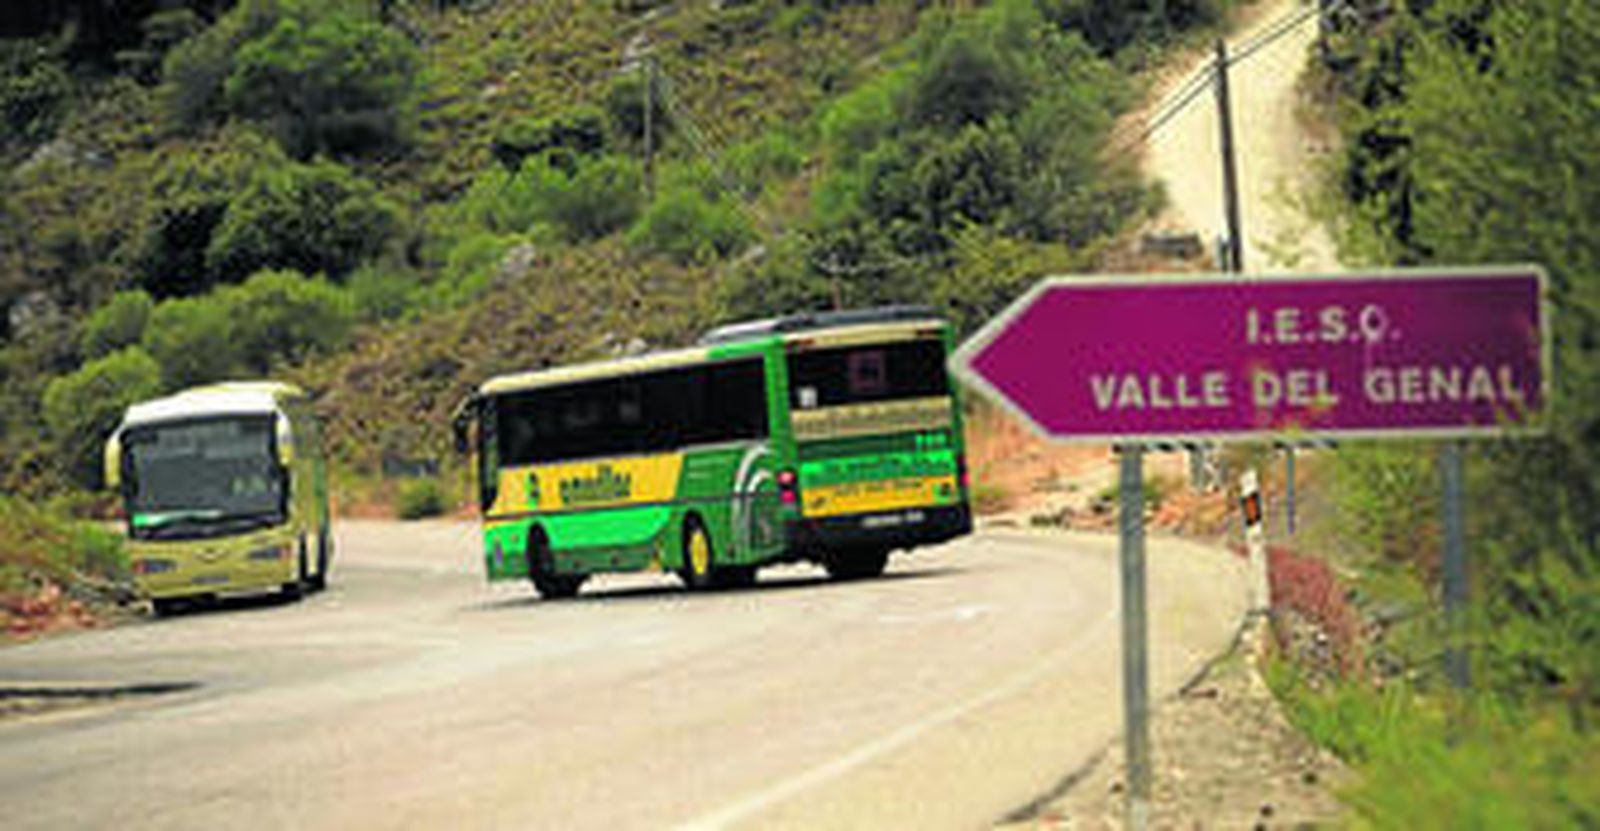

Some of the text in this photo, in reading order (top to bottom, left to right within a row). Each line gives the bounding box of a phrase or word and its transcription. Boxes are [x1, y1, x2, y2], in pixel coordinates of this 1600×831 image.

[1091, 366, 1524, 408] VALLE DEL GENAL
